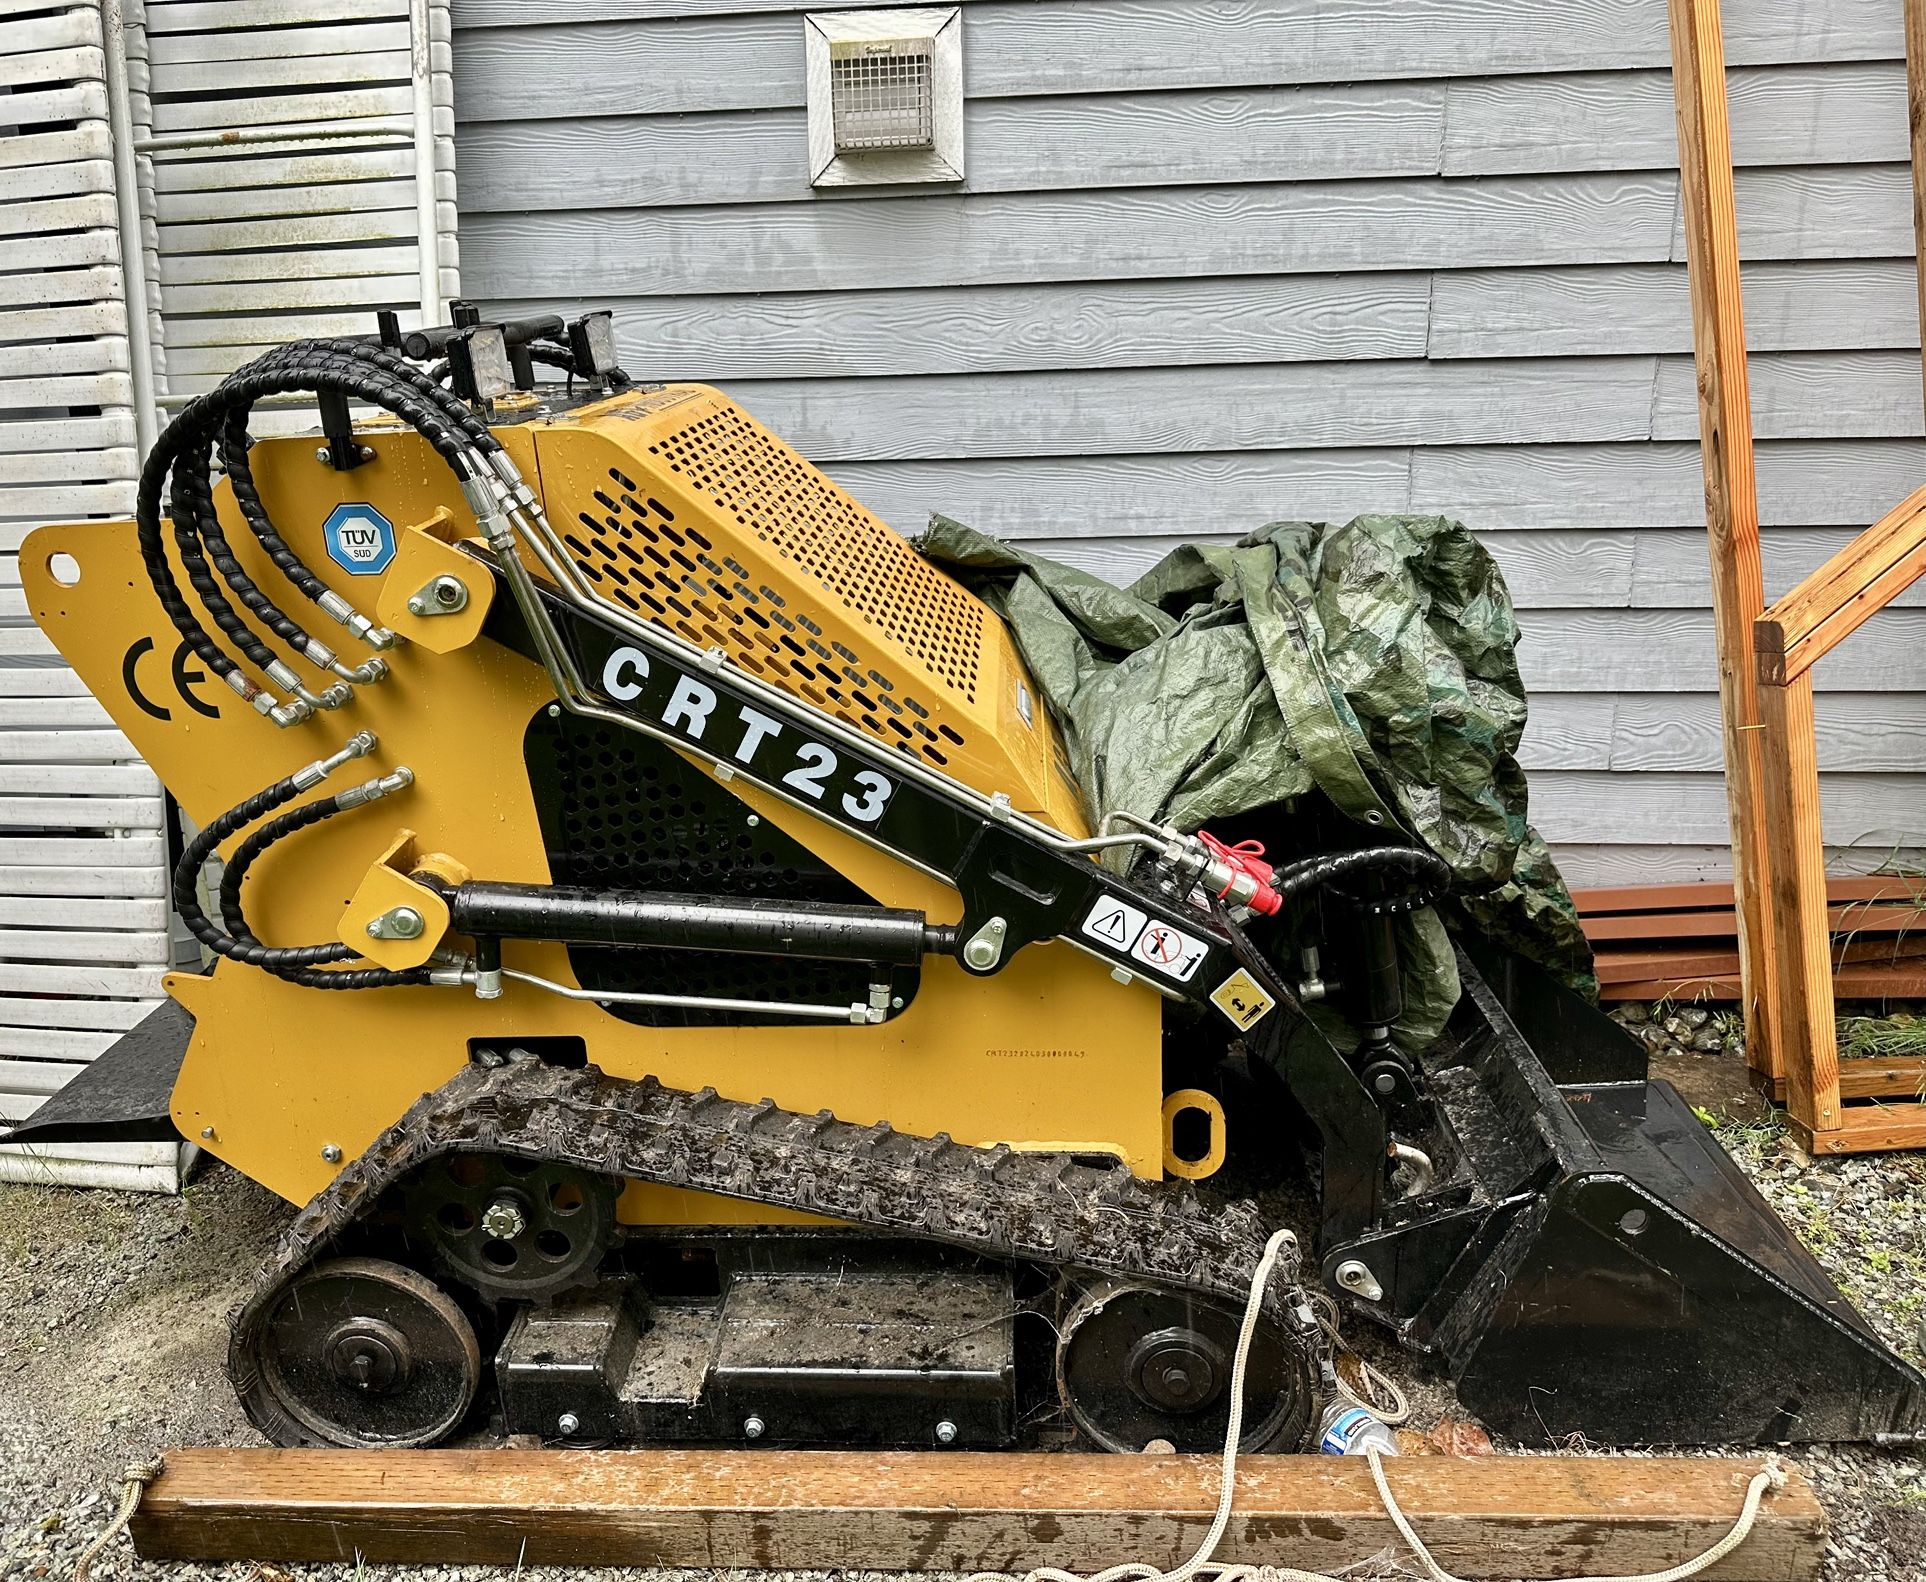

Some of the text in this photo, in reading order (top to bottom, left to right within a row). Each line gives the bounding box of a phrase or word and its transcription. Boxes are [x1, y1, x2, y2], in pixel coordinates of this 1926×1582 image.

[341, 529, 376, 545] TÜV
[122, 636, 221, 721] CE
[602, 646, 893, 822] CRT23
